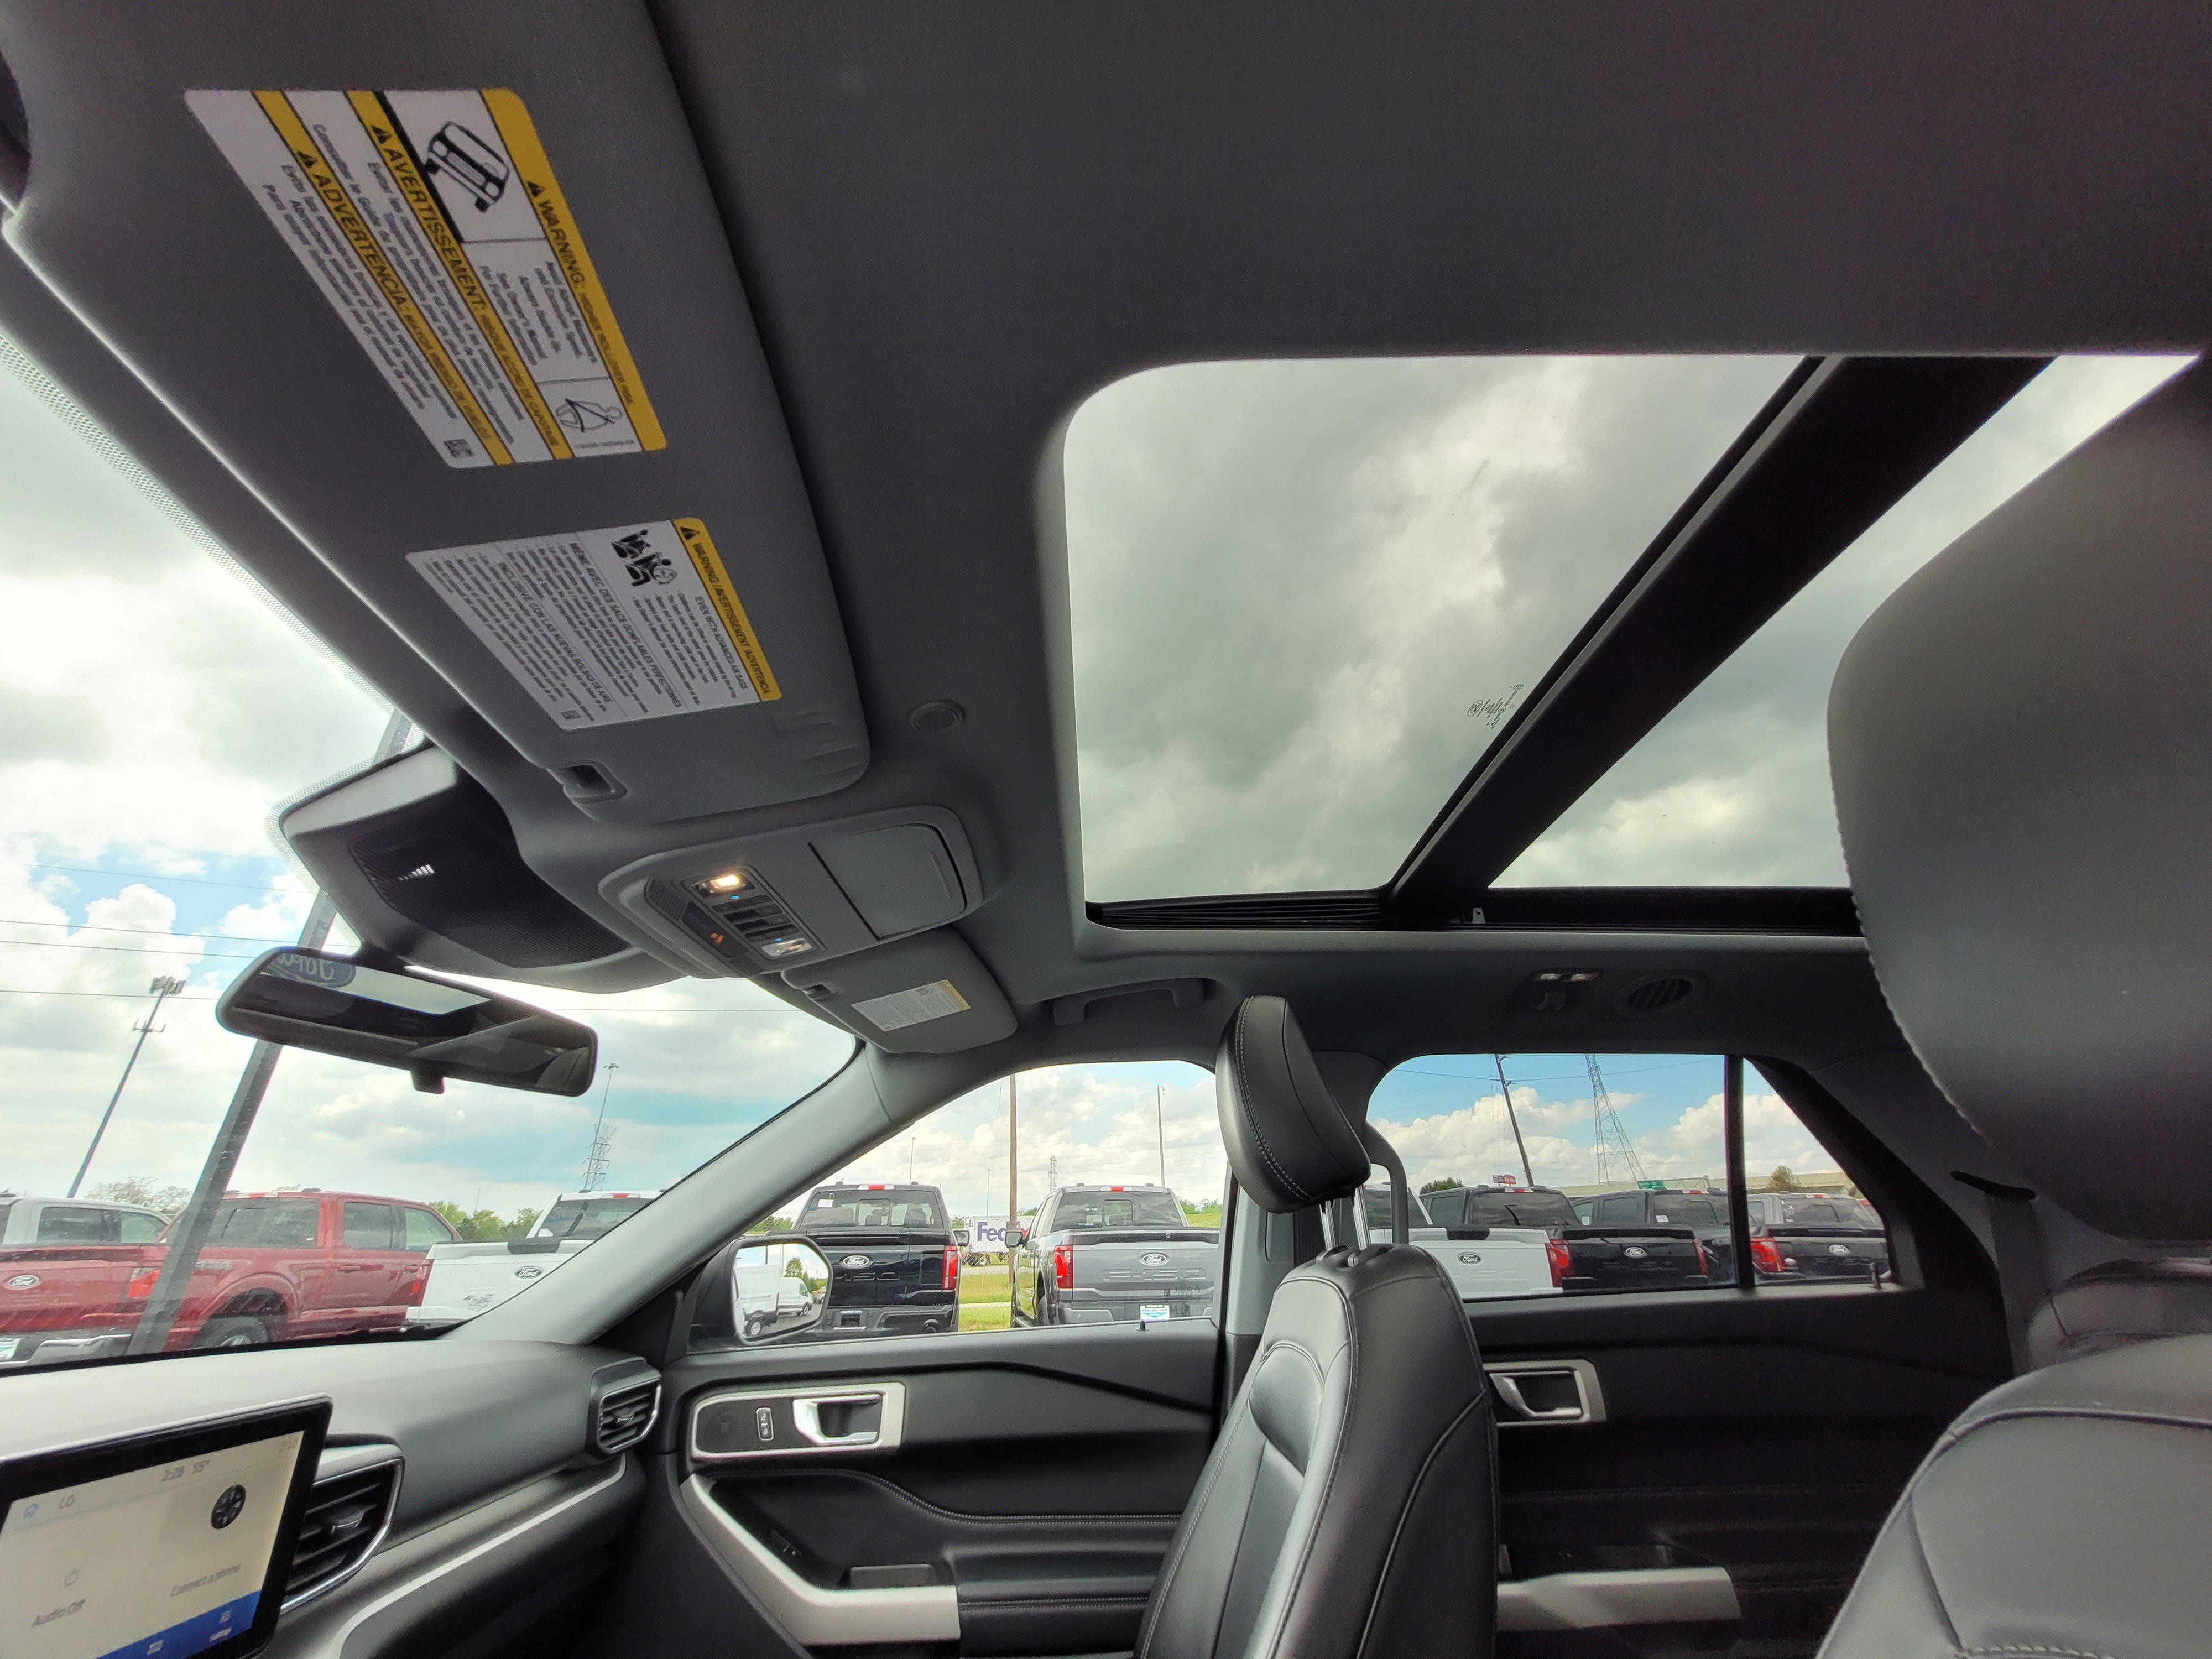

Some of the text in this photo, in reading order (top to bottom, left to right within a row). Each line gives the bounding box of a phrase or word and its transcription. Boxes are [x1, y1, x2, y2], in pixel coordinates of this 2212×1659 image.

[311, 174, 414, 310] ADVERTENCIA:
[382, 148, 490, 310] AVERTISSEMENT:
[535, 200, 589, 288] WARNING:
[495, 562, 534, 601] INCLUSIVE
[528, 602, 546, 618] CON
[540, 618, 557, 632] LAS
[551, 633, 578, 658] NUEVAS
[571, 658, 596, 681] BOLSAS
[597, 690, 613, 702] AIRE
[584, 567, 605, 587] AVEC
[598, 588, 615, 603] DES
[608, 604, 628, 623] SACS
[622, 624, 654, 663] GONFLABLES
[694, 596, 748, 689] EVEN WITH ADVANCED AIR BAGS
[517, 1267, 541, 1277] Ford
[845, 1256, 867, 1266] Ford
[977, 1222, 1029, 1241] Fed
[1145, 1254, 1164, 1263] Ford
[1460, 1253, 1480, 1264] Ford
